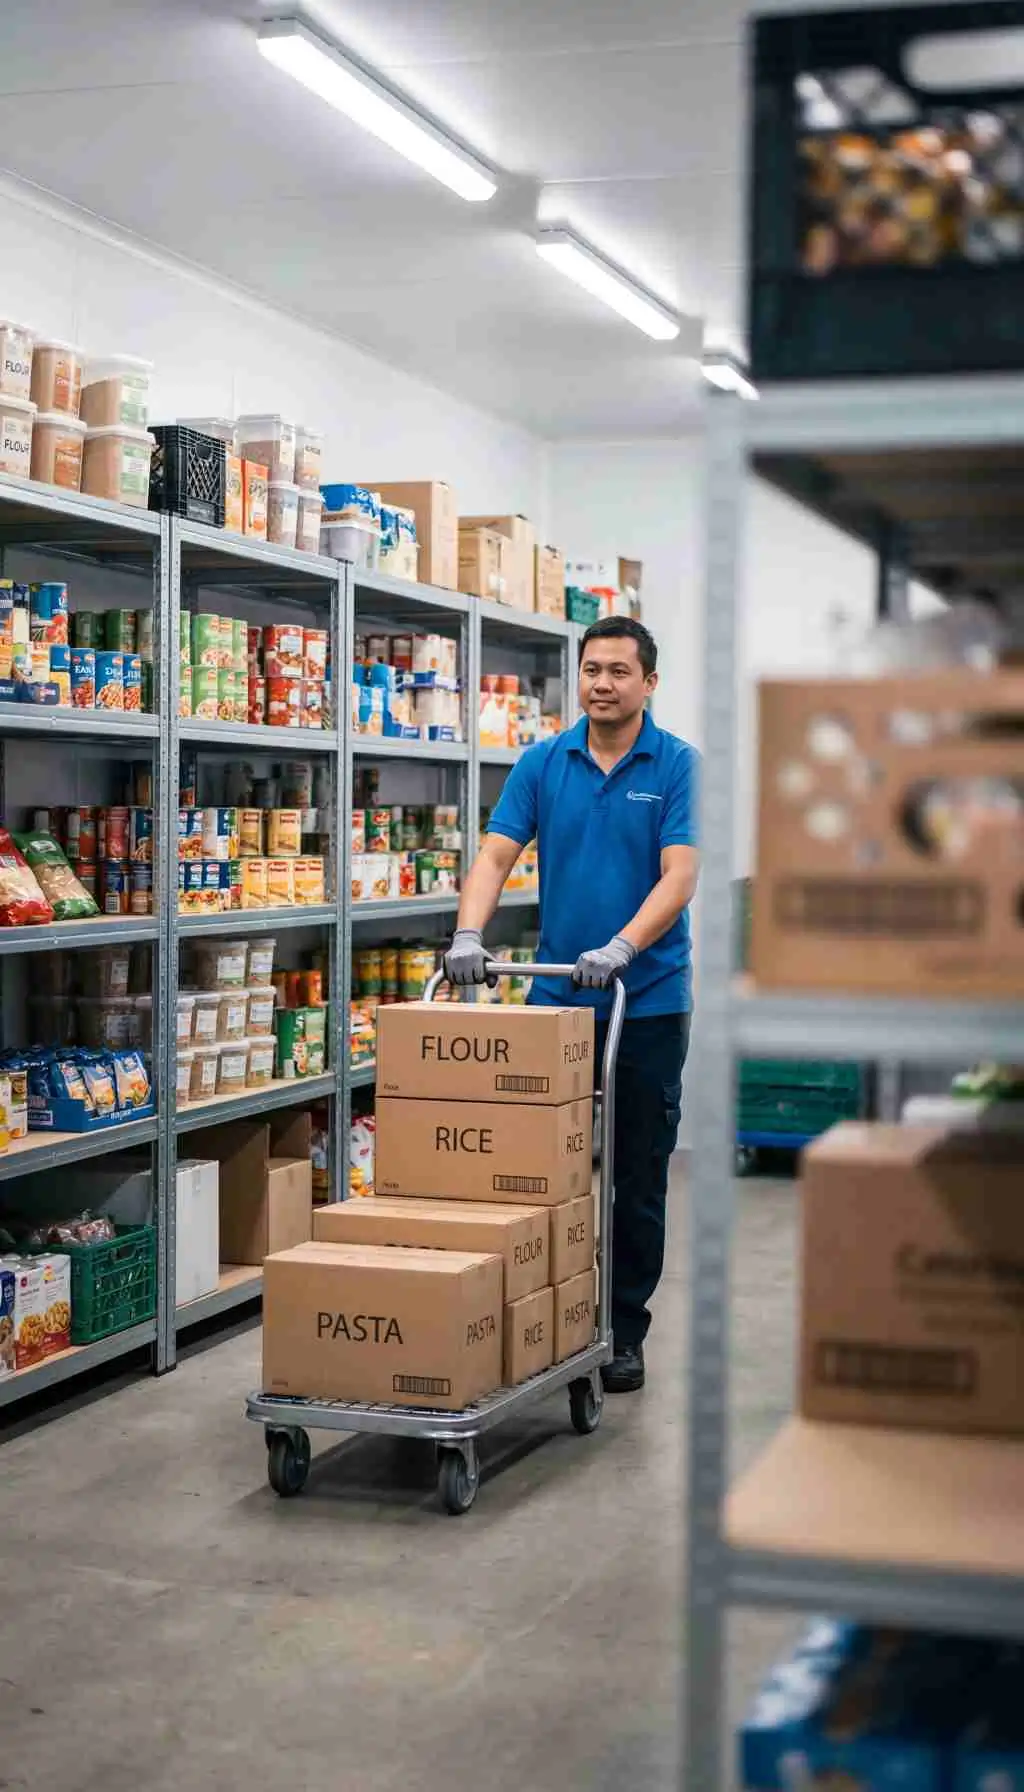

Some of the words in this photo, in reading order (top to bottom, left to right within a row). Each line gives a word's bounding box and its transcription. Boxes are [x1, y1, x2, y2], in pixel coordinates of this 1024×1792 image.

[421, 1035, 511, 1063] FLOUR
[564, 1040, 589, 1065] FLOUR
[435, 1126, 494, 1154] RICE
[566, 1132, 584, 1154] RICE
[567, 1221, 585, 1249] RICE
[514, 1237, 544, 1265] FLOUR
[564, 1299, 590, 1326] PASTA
[317, 1312, 403, 1345] PASTA
[467, 1315, 496, 1346] PASTA
[524, 1320, 544, 1349] RICE
